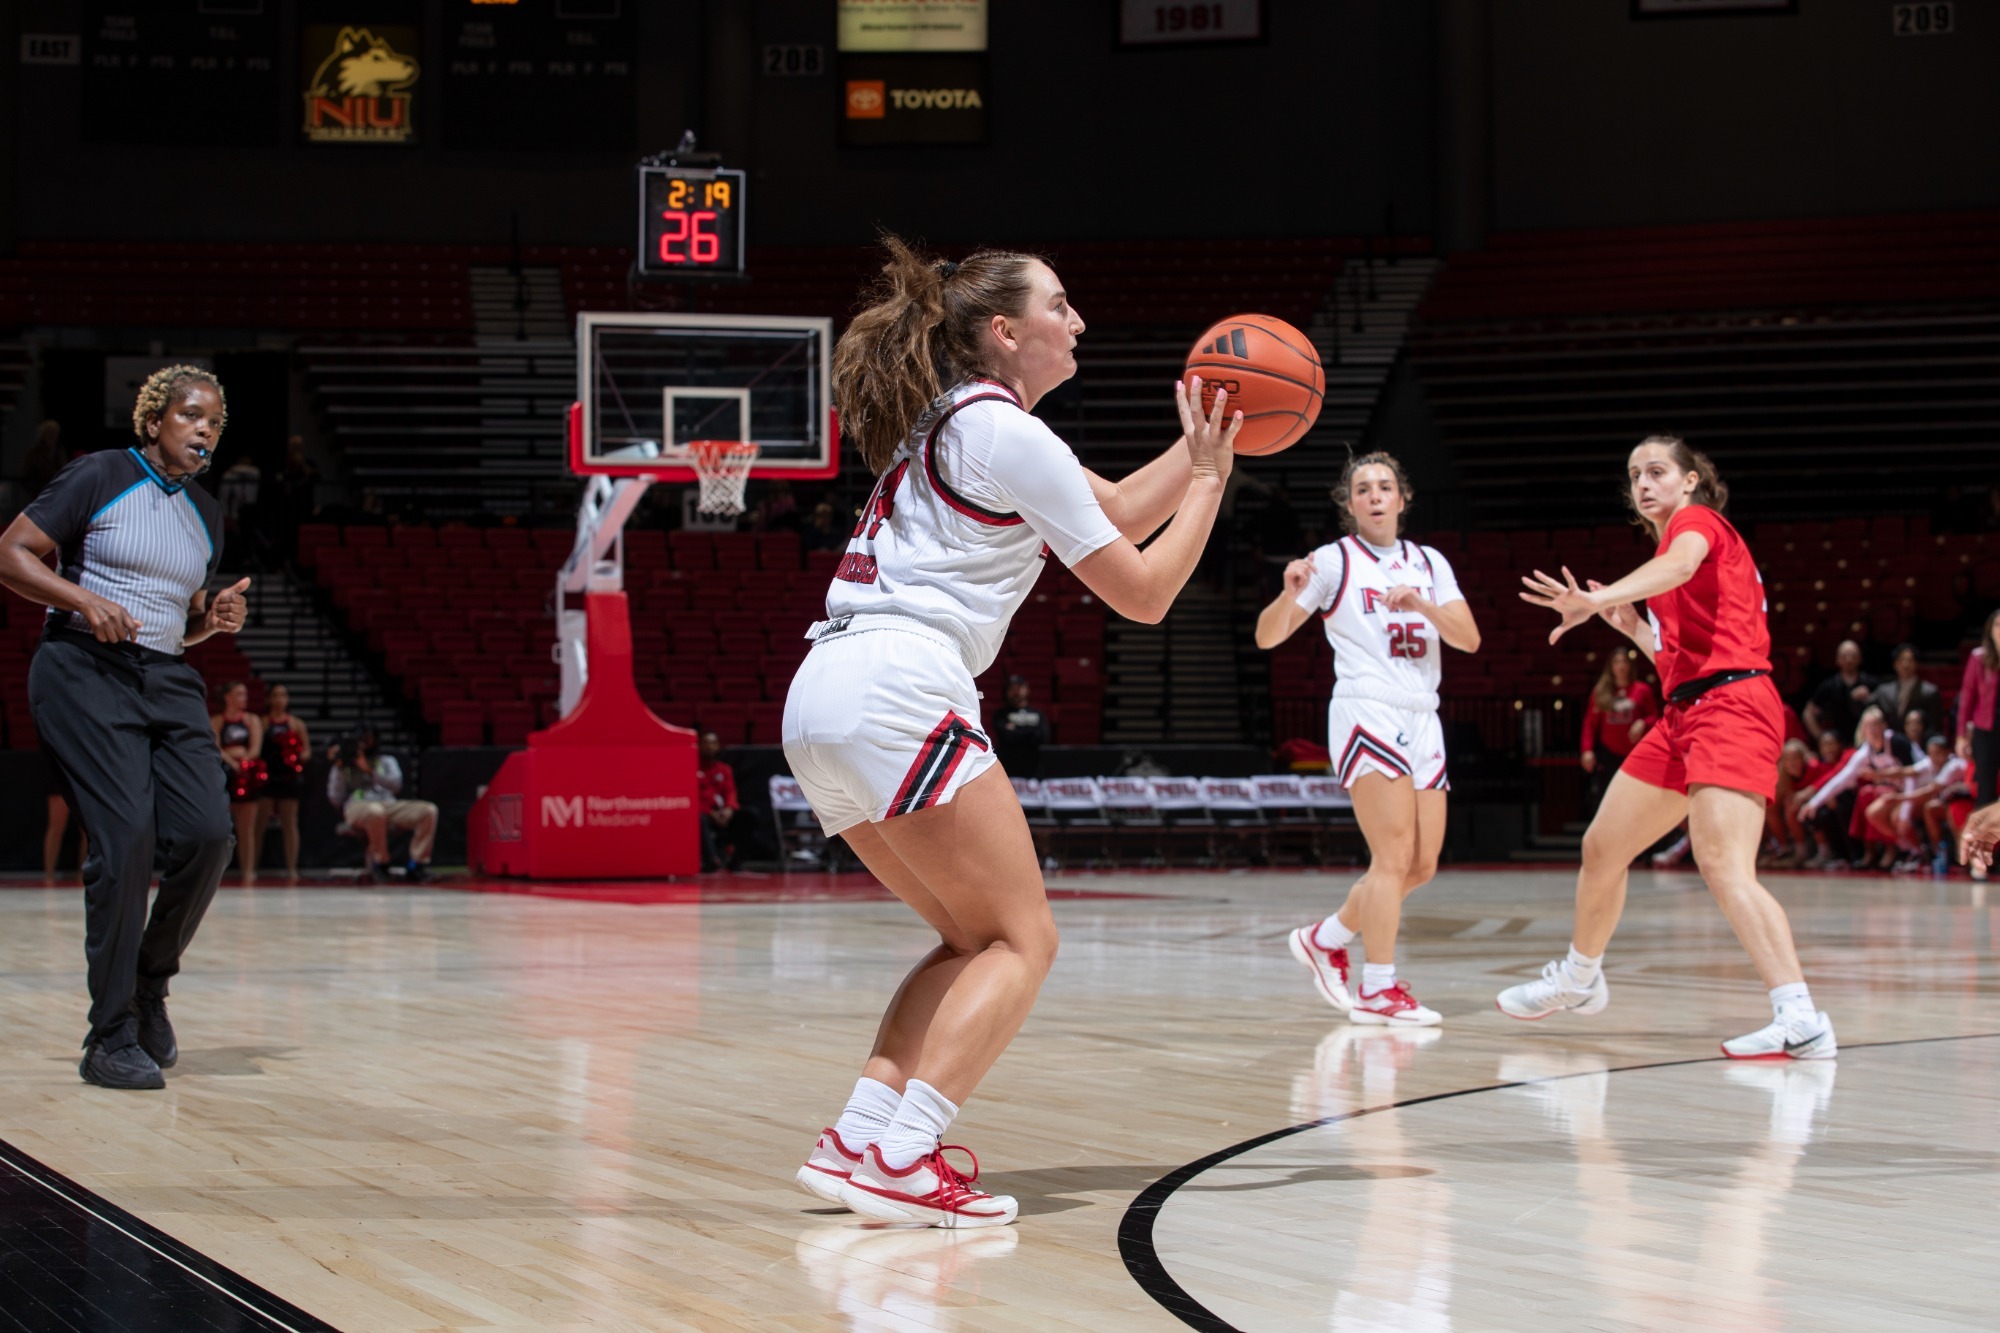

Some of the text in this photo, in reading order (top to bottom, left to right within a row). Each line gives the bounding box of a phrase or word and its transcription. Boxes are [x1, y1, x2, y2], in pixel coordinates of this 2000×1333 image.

[1156, 4, 1222, 33] 1981
[1898, 5, 1949, 32] 209
[31, 40, 71, 57] EAST
[769, 48, 818, 72] 208
[312, 97, 404, 128] NIU
[890, 89, 983, 109] TOYOTA
[668, 179, 731, 208] 2:19
[659, 210, 720, 263] 26
[1387, 622, 1426, 659] 25
[587, 796, 690, 811] Northwestern
[587, 813, 651, 827] Medicine
